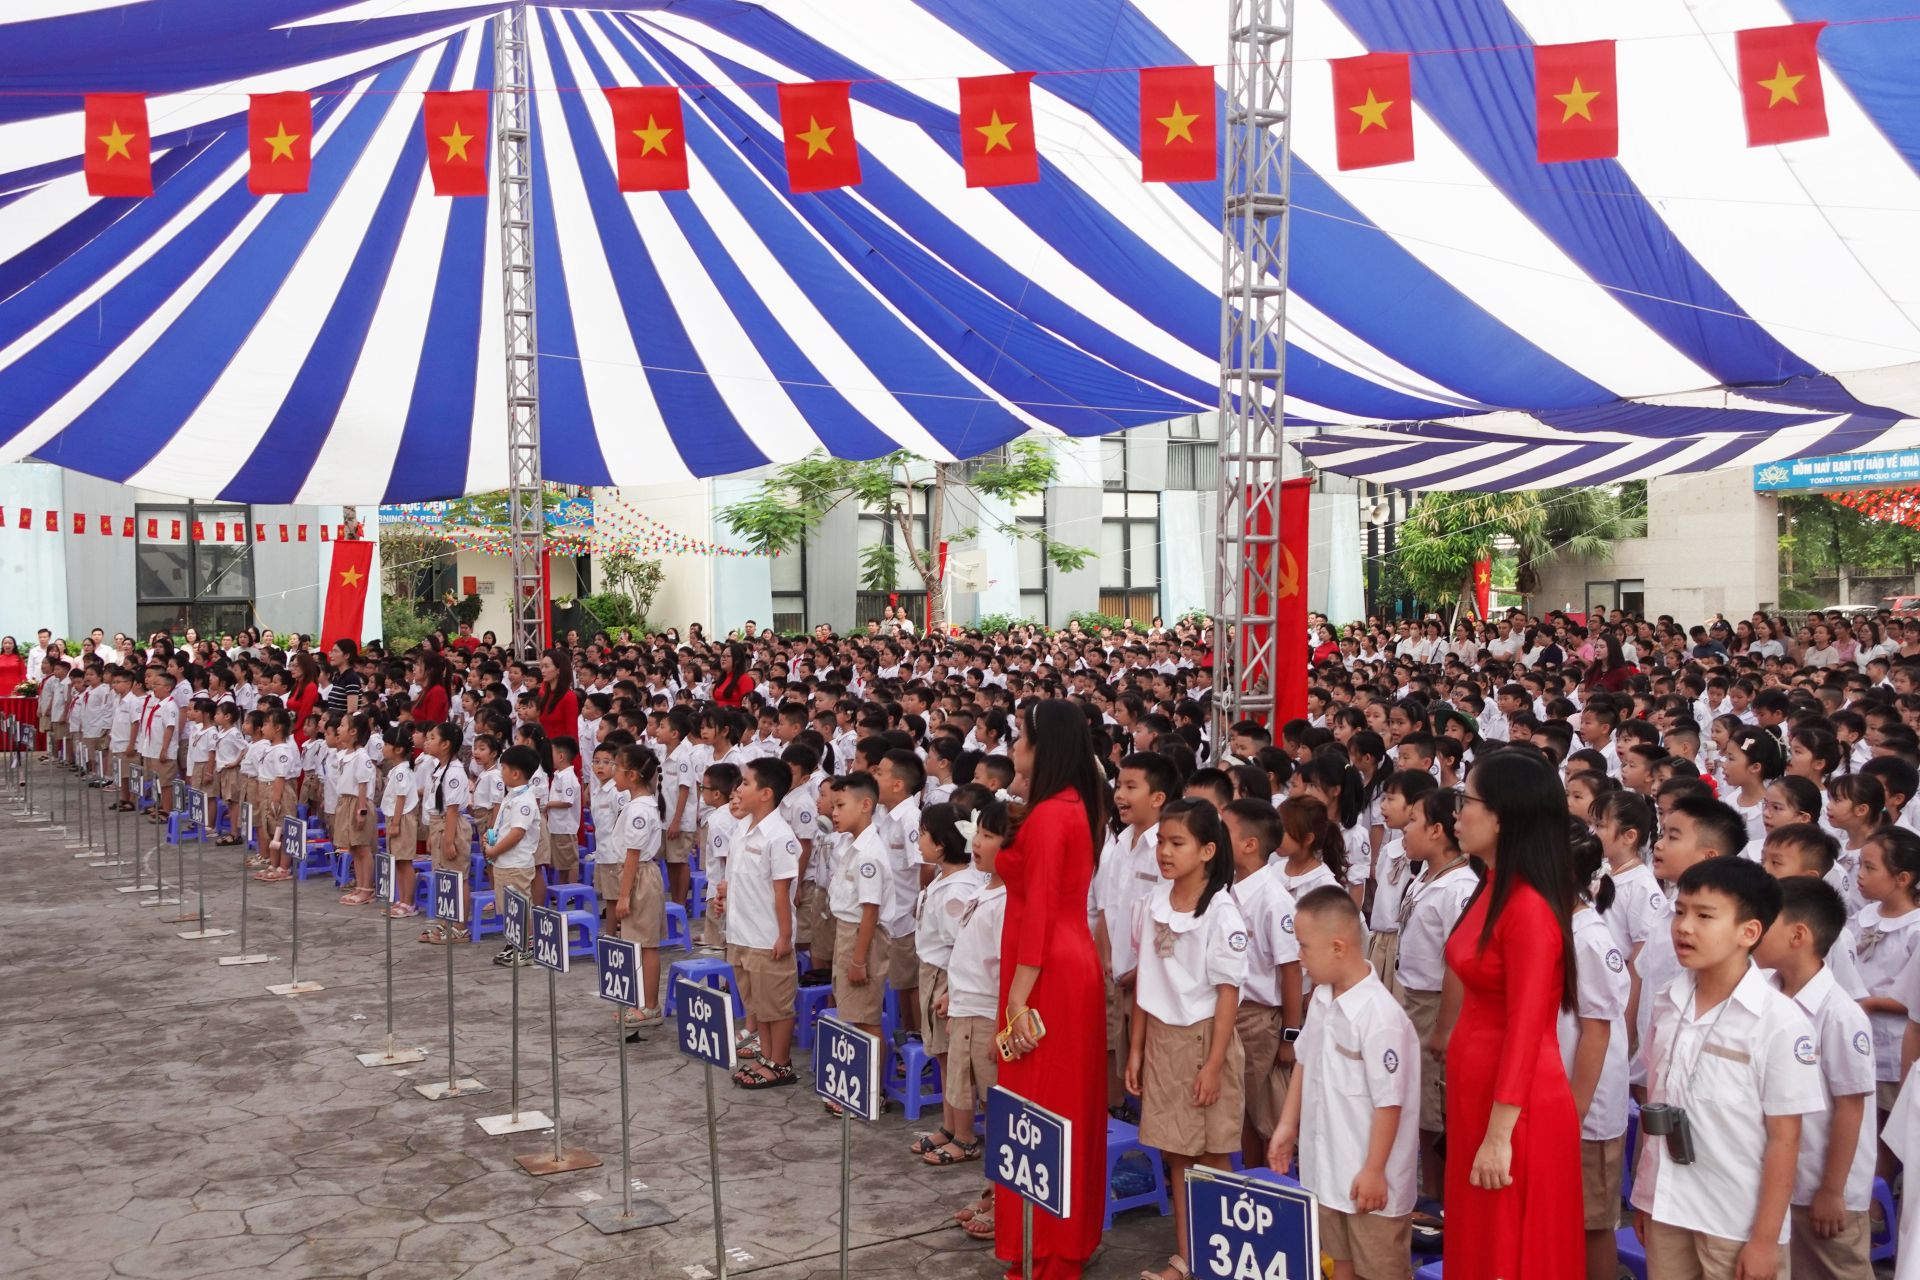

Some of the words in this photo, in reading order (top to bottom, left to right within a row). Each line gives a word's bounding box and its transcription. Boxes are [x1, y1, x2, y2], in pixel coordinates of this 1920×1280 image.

[1809, 476, 1834, 484] TODAY
[1862, 473, 1889, 481] PROUD
[1891, 471, 1902, 479] OF
[1903, 470, 1919, 478] THE
[1814, 461, 1831, 474] NAY
[285, 838, 300, 857] 2A2
[440, 875, 452, 893] LỚP
[437, 895, 455, 918] 2A4
[507, 897, 519, 917] LỚP
[505, 916, 521, 945] 2A5
[540, 916, 553, 937] LỚP
[537, 939, 558, 966] 2A6
[608, 948, 625, 969] LỚP
[604, 971, 630, 1001] 2A7
[688, 995, 713, 1024] LỚP
[686, 1022, 721, 1061] 3A1
[831, 1034, 856, 1066] LỚP
[825, 1063, 861, 1109] 3A2
[1008, 1112, 1042, 1150] LỚP
[998, 1144, 1050, 1201] 3A3
[1220, 1192, 1273, 1235] LỚP
[1208, 1233, 1291, 1280] 3A4
